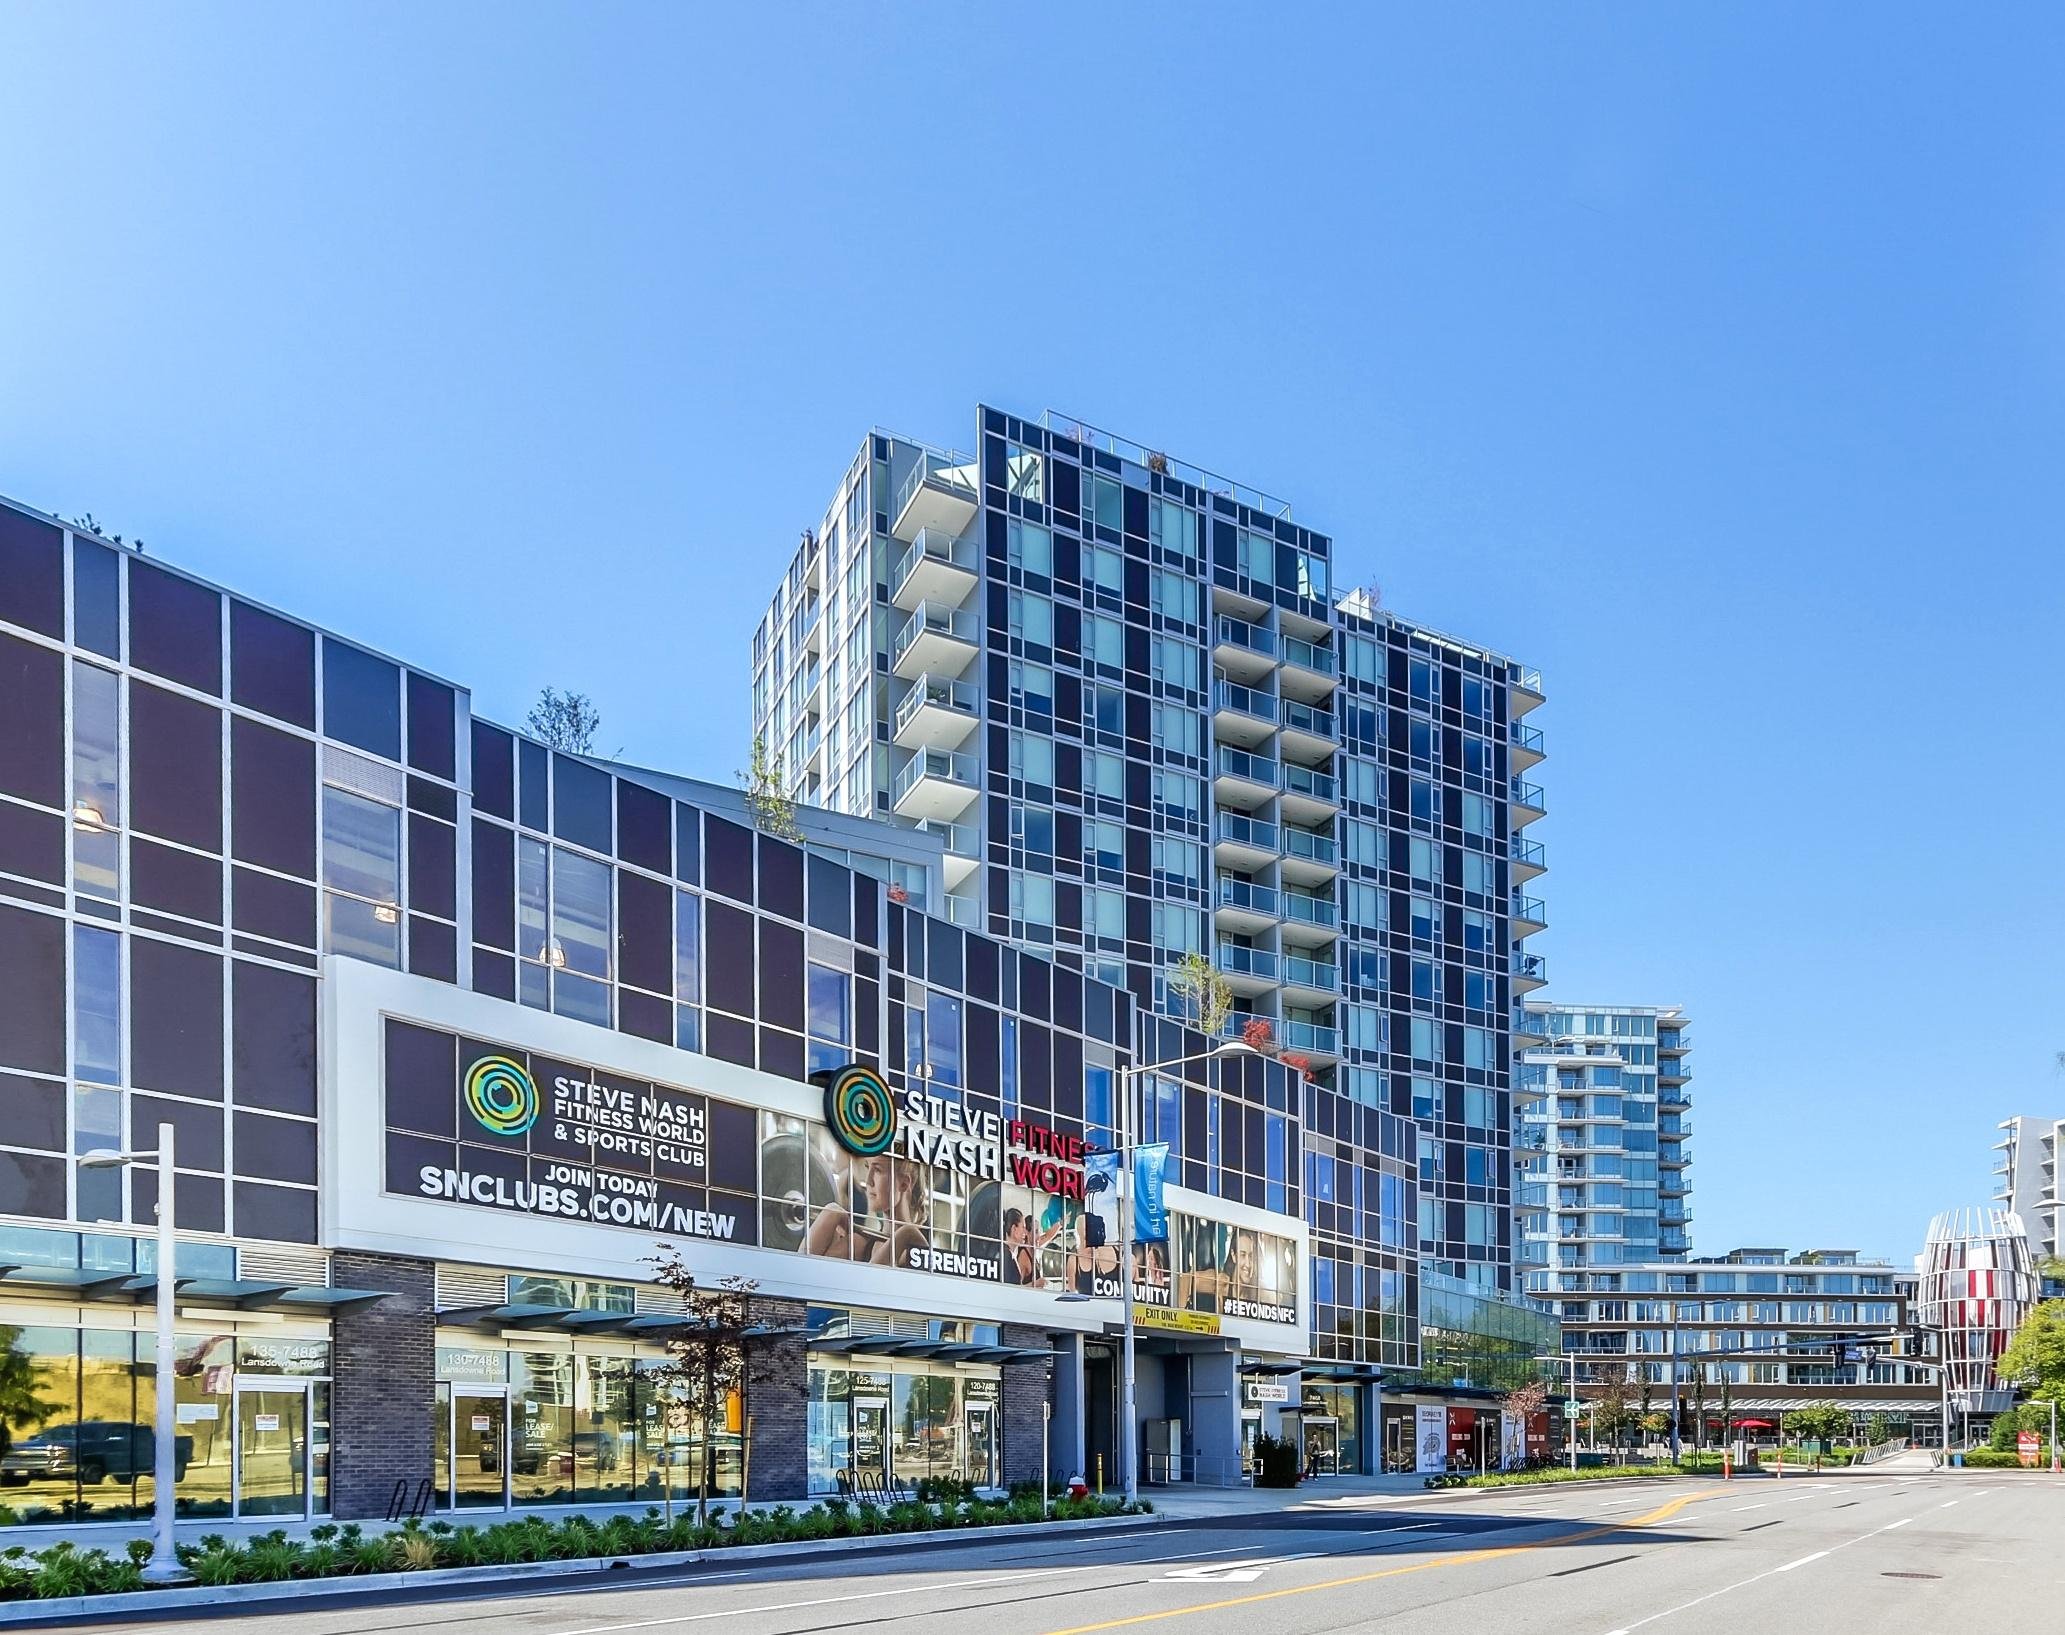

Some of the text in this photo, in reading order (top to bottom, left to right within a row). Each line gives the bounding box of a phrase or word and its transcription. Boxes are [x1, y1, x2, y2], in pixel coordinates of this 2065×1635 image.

[554, 1076, 704, 1129] STEVE NASH
[554, 1099, 705, 1145] FITNESS WORLD
[905, 1090, 1095, 1164] STEVE FITNE
[554, 1124, 705, 1167] & SPORTS CLUB
[905, 1125, 1086, 1200] NASH WOR
[545, 1164, 658, 1198] JOIN TODAY
[420, 1165, 736, 1240] SNCLUBS.COM/NEW
[909, 1247, 998, 1279] STRENGTH
[1094, 1277, 1170, 1305] COMUNITY
[1145, 1307, 1160, 1319] EXIT
[1224, 1298, 1295, 1323] #BEYONDSNFC
[250, 1345, 318, 1359] 135-7488
[300, 1359, 325, 1369] Road
[448, 1353, 500, 1366] 130-7488
[440, 1366, 506, 1376] Lansdowne Road
[525, 1430, 546, 1439] SALE
[645, 1424, 664, 1432] LEAS
